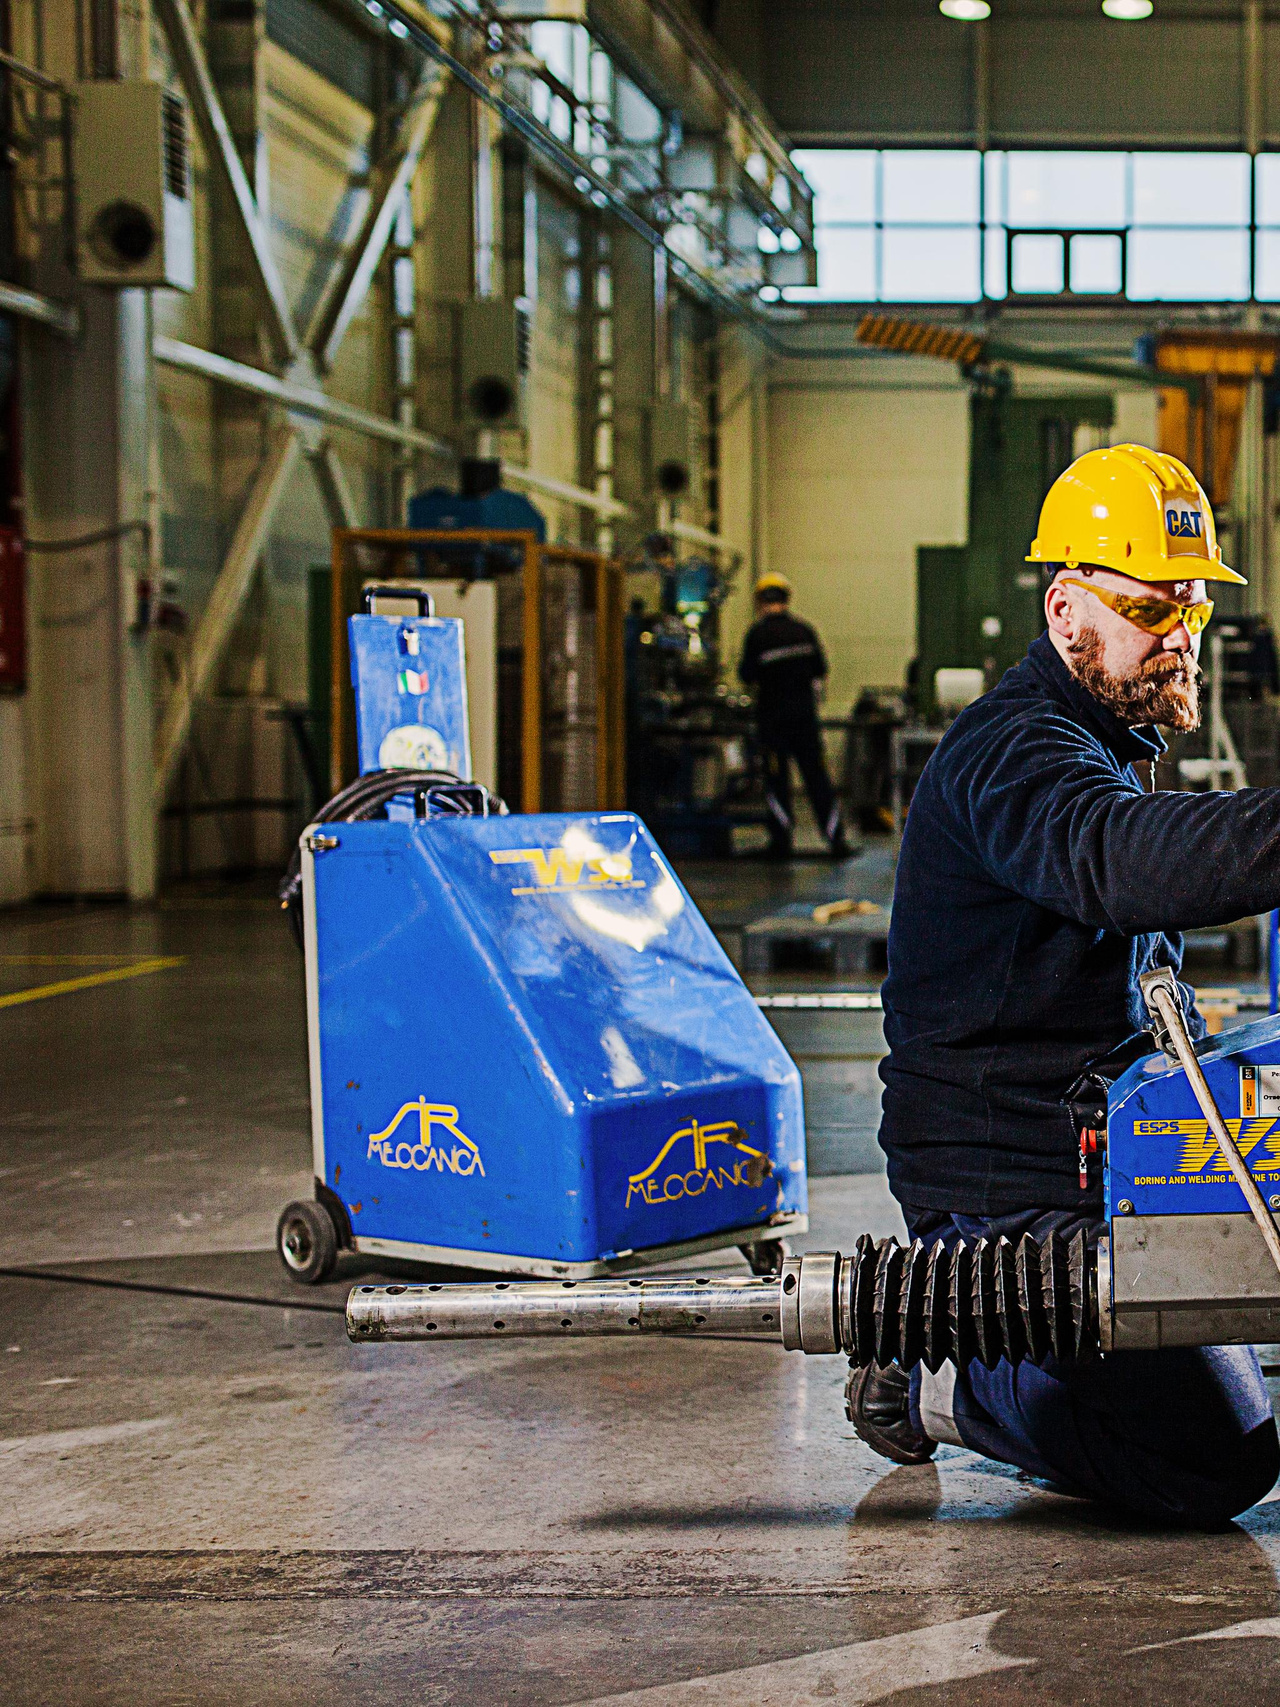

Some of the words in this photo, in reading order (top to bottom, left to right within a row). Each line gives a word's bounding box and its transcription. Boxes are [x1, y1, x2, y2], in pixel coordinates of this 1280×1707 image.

[1166, 509, 1202, 538] CAT
[1134, 1176, 1166, 1185] BORING
[1169, 1176, 1186, 1184] AND
[1188, 1174, 1226, 1184] WELDING
